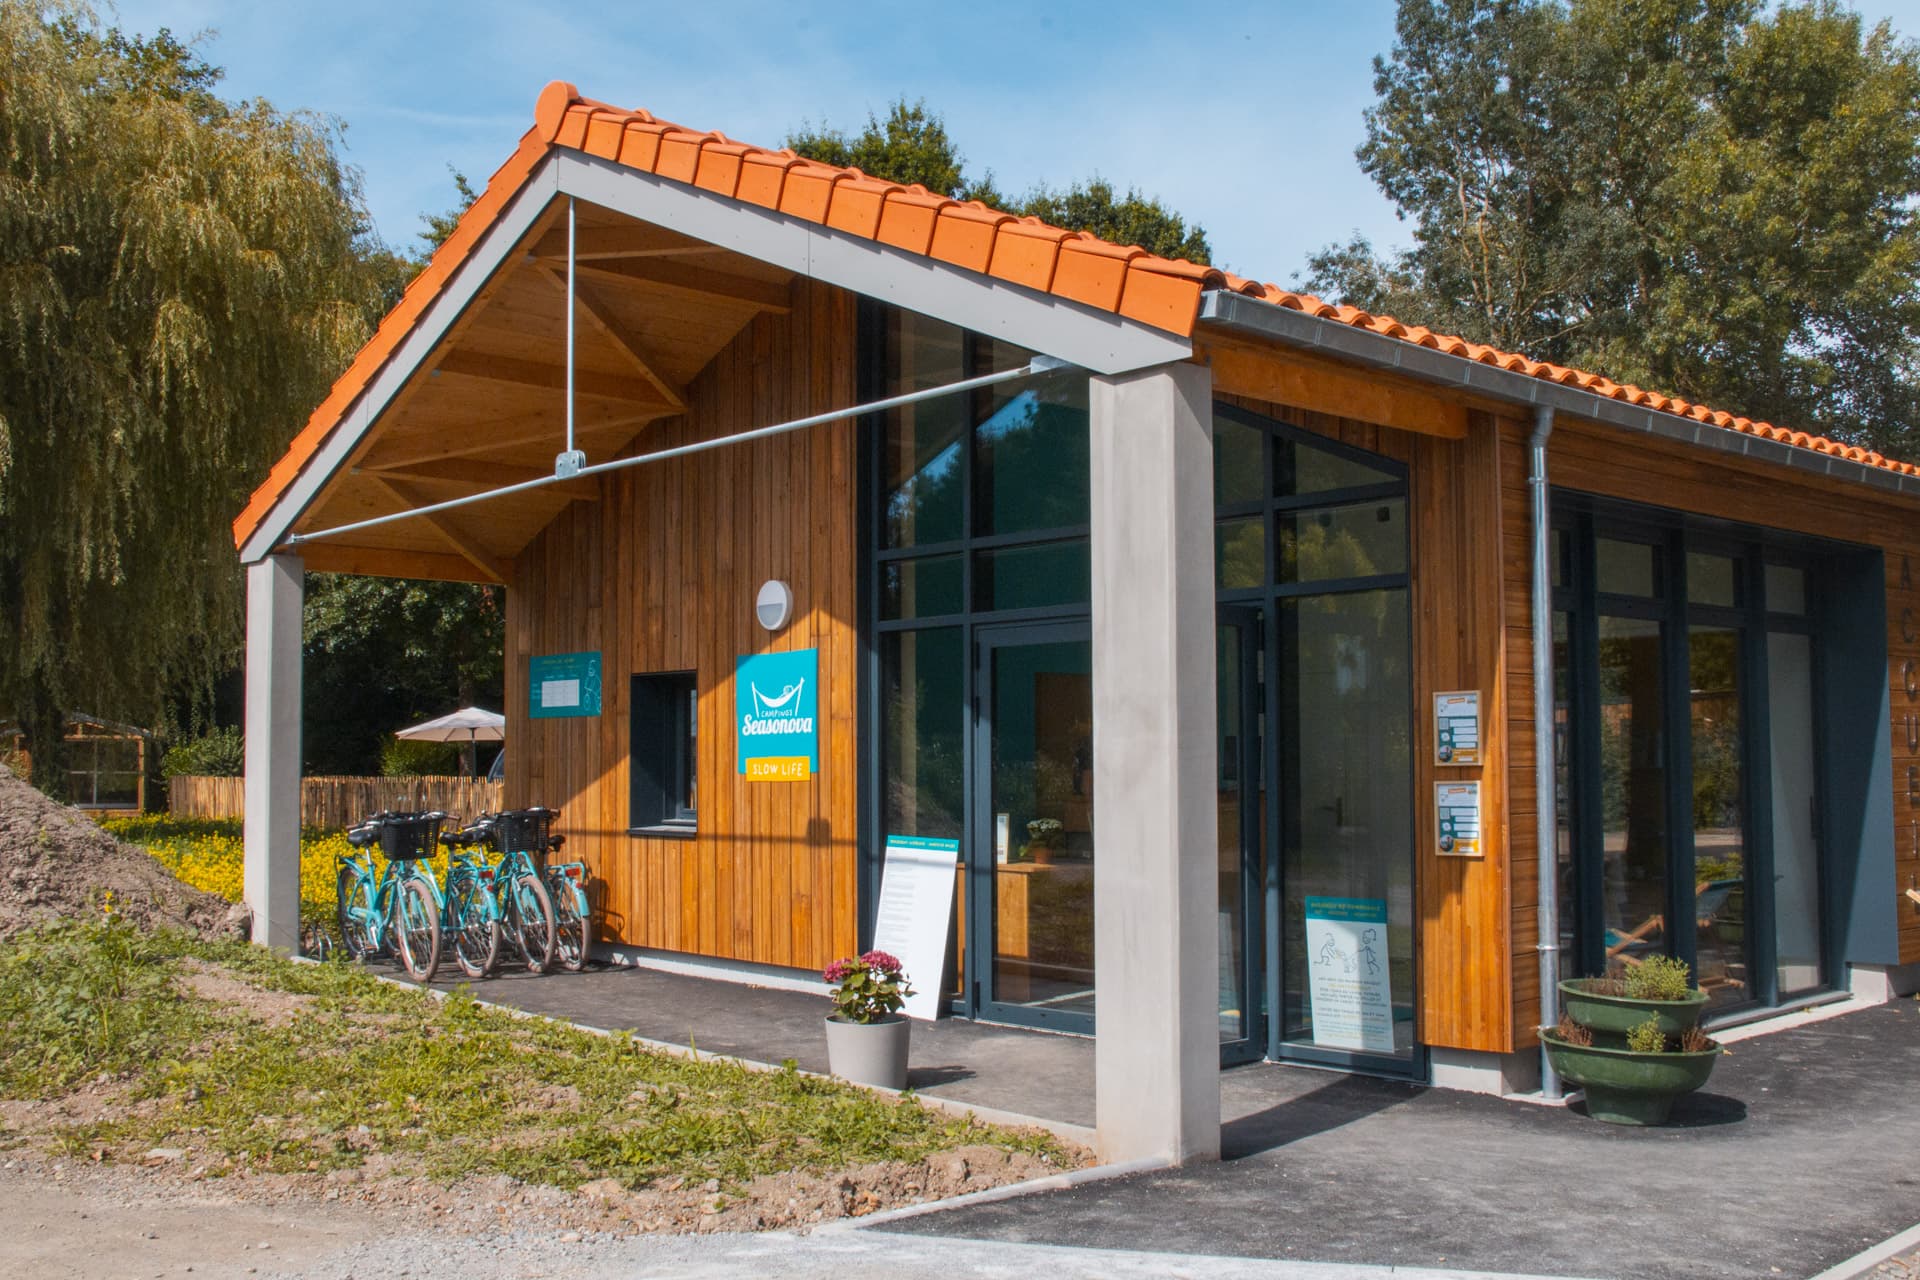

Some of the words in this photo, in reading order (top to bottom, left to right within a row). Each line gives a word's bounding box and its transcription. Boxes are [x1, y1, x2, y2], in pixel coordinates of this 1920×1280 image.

[761, 709, 792, 717] CAMPINGS
[742, 714, 812, 736] Seasonova
[752, 763, 778, 775] SLOW
[781, 763, 803, 776] LIFE
